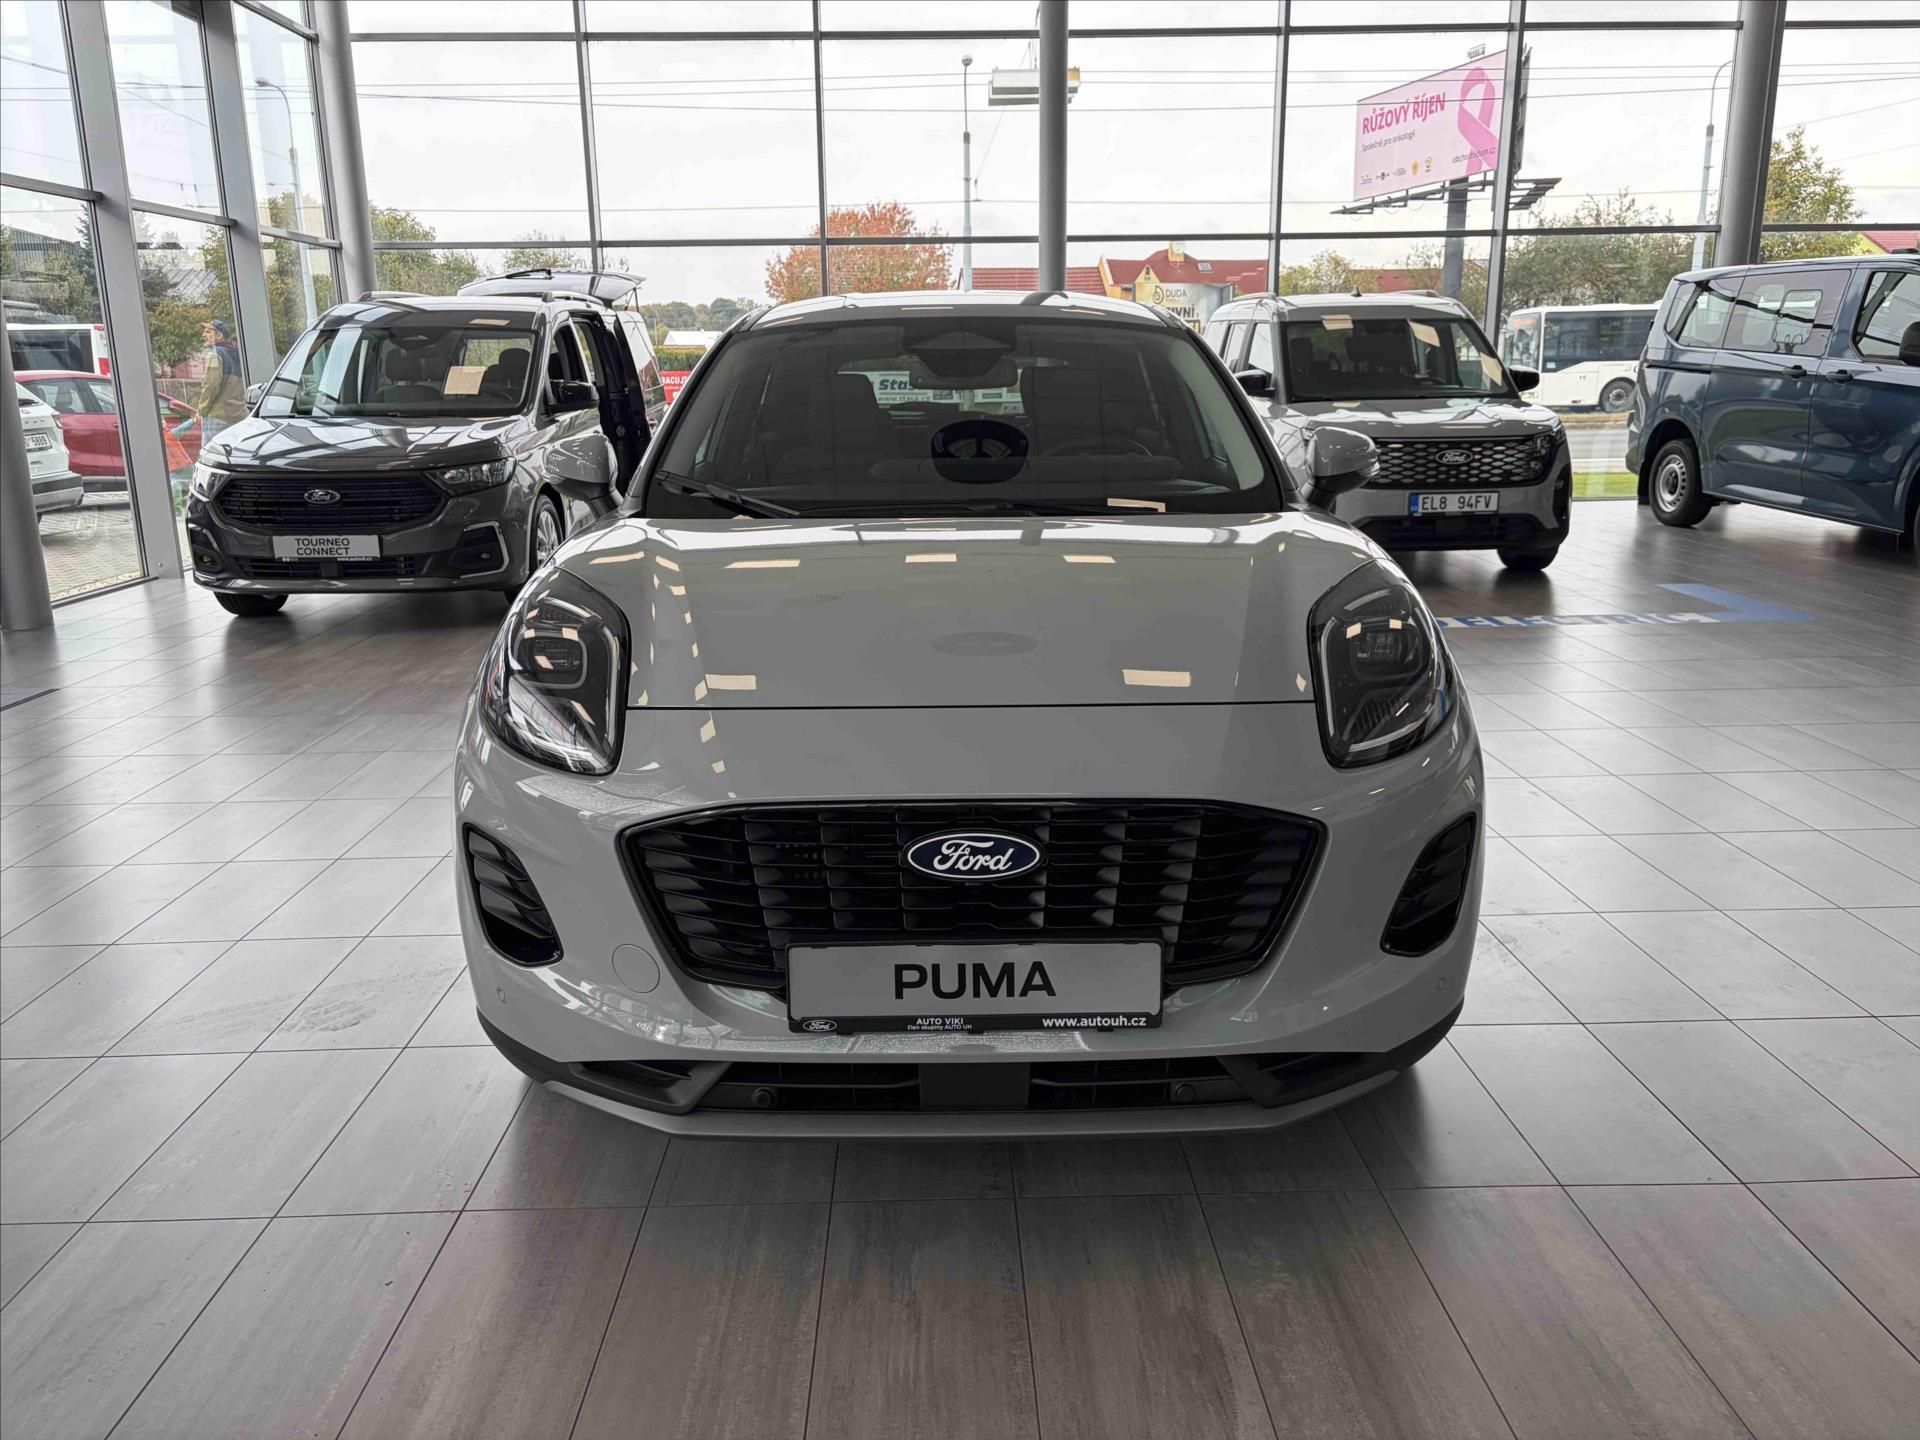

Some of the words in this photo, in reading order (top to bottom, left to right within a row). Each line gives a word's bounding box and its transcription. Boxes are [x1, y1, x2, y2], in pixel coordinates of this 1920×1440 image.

[1362, 99, 1410, 135] RŮŽOVÝ
[1412, 92, 1446, 122] ŘÍJEN
[1165, 289, 1187, 298] DUDA
[1421, 496, 1447, 510] EL8
[1457, 495, 1492, 510] 94FV
[294, 538, 350, 546] TOURNEO
[296, 547, 350, 556] CONNECT
[933, 840, 1014, 870] Ford
[893, 960, 1056, 999] PUMA
[1042, 1015, 1147, 1027] www.autouh.cz
